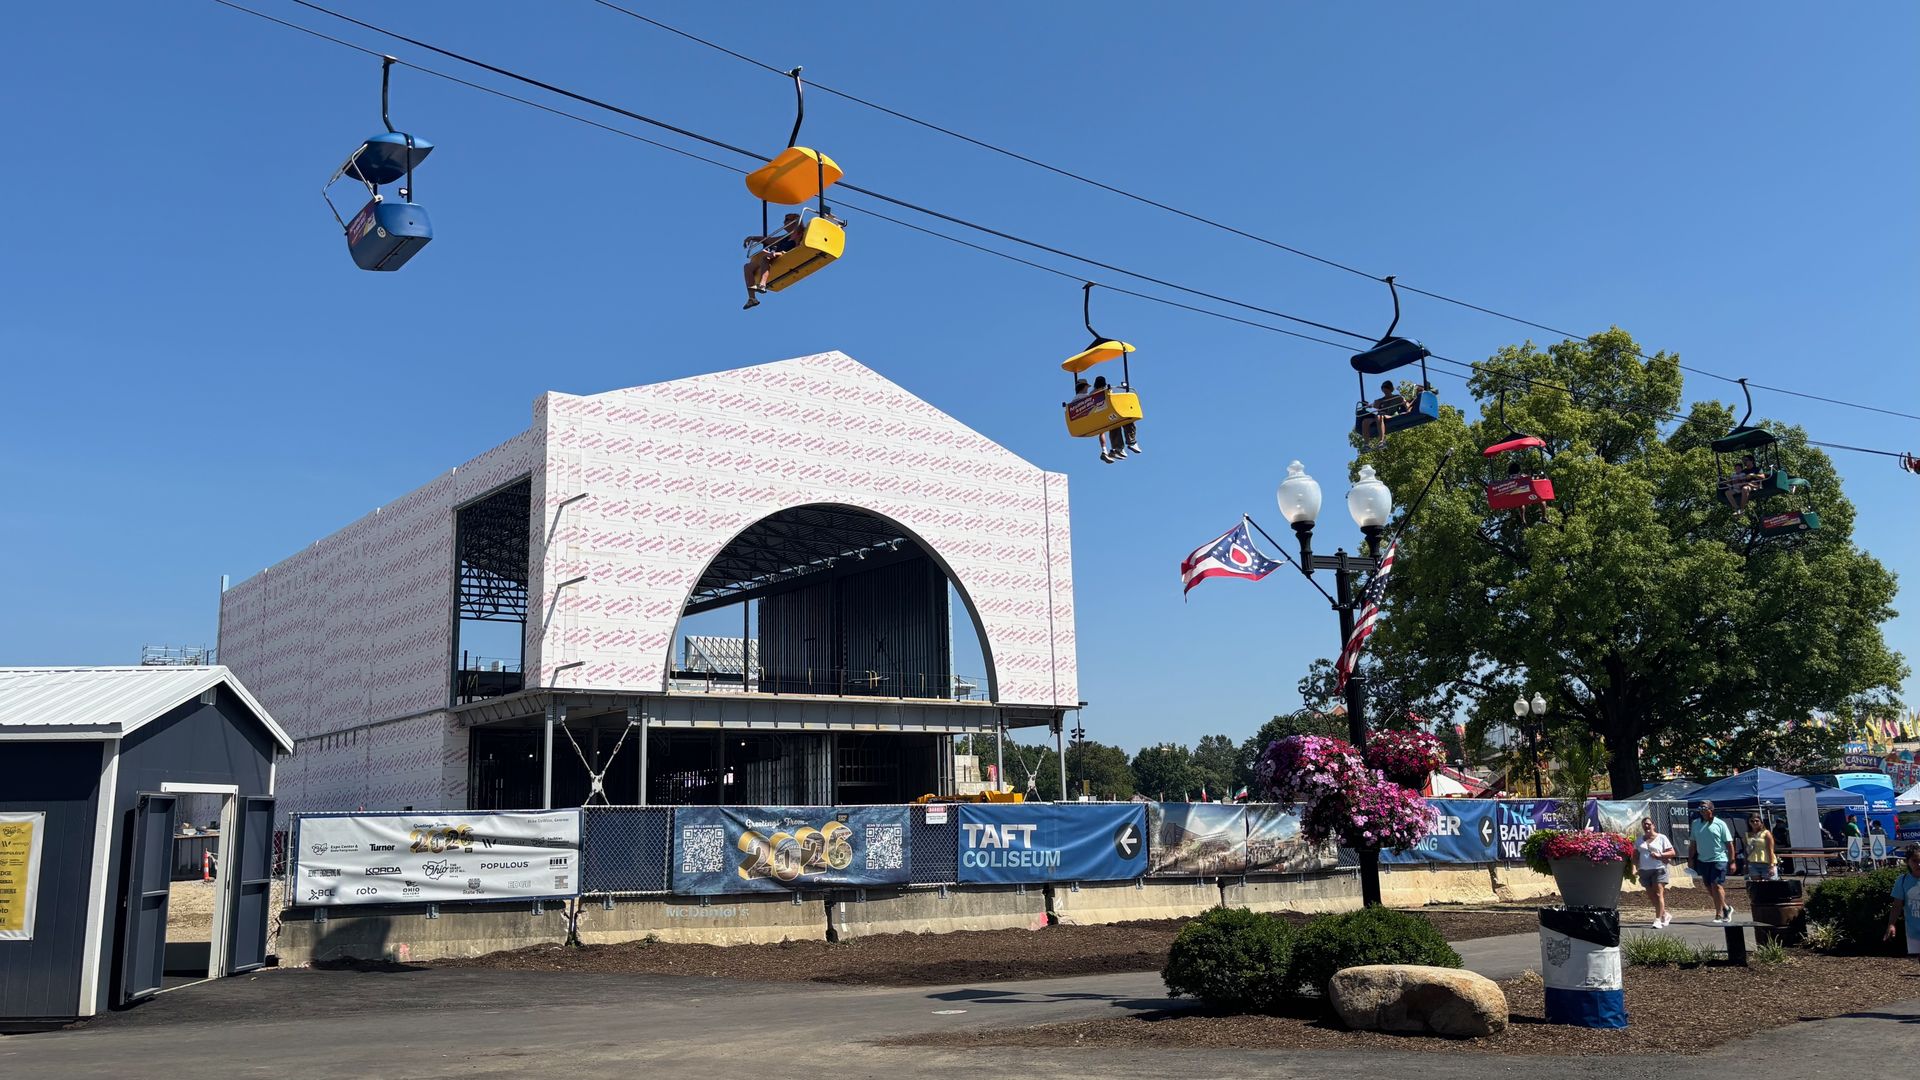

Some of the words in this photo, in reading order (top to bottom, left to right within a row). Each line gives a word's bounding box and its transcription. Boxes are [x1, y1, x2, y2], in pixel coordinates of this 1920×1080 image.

[1499, 803, 1536, 824] THE
[1670, 807, 1685, 816] OHIO
[745, 818, 782, 829] Greetings
[409, 824, 474, 854] 2026
[962, 823, 1037, 849] TAFT
[1500, 824, 1537, 841] BARN
[369, 843, 395, 852] Turner
[738, 821, 853, 881] 2026
[480, 861, 529, 870] POPULOUS
[962, 850, 1061, 868] COLISEUM
[365, 866, 402, 876] KORDA
[422, 864, 449, 877] Ohio
[356, 886, 378, 896] roto
